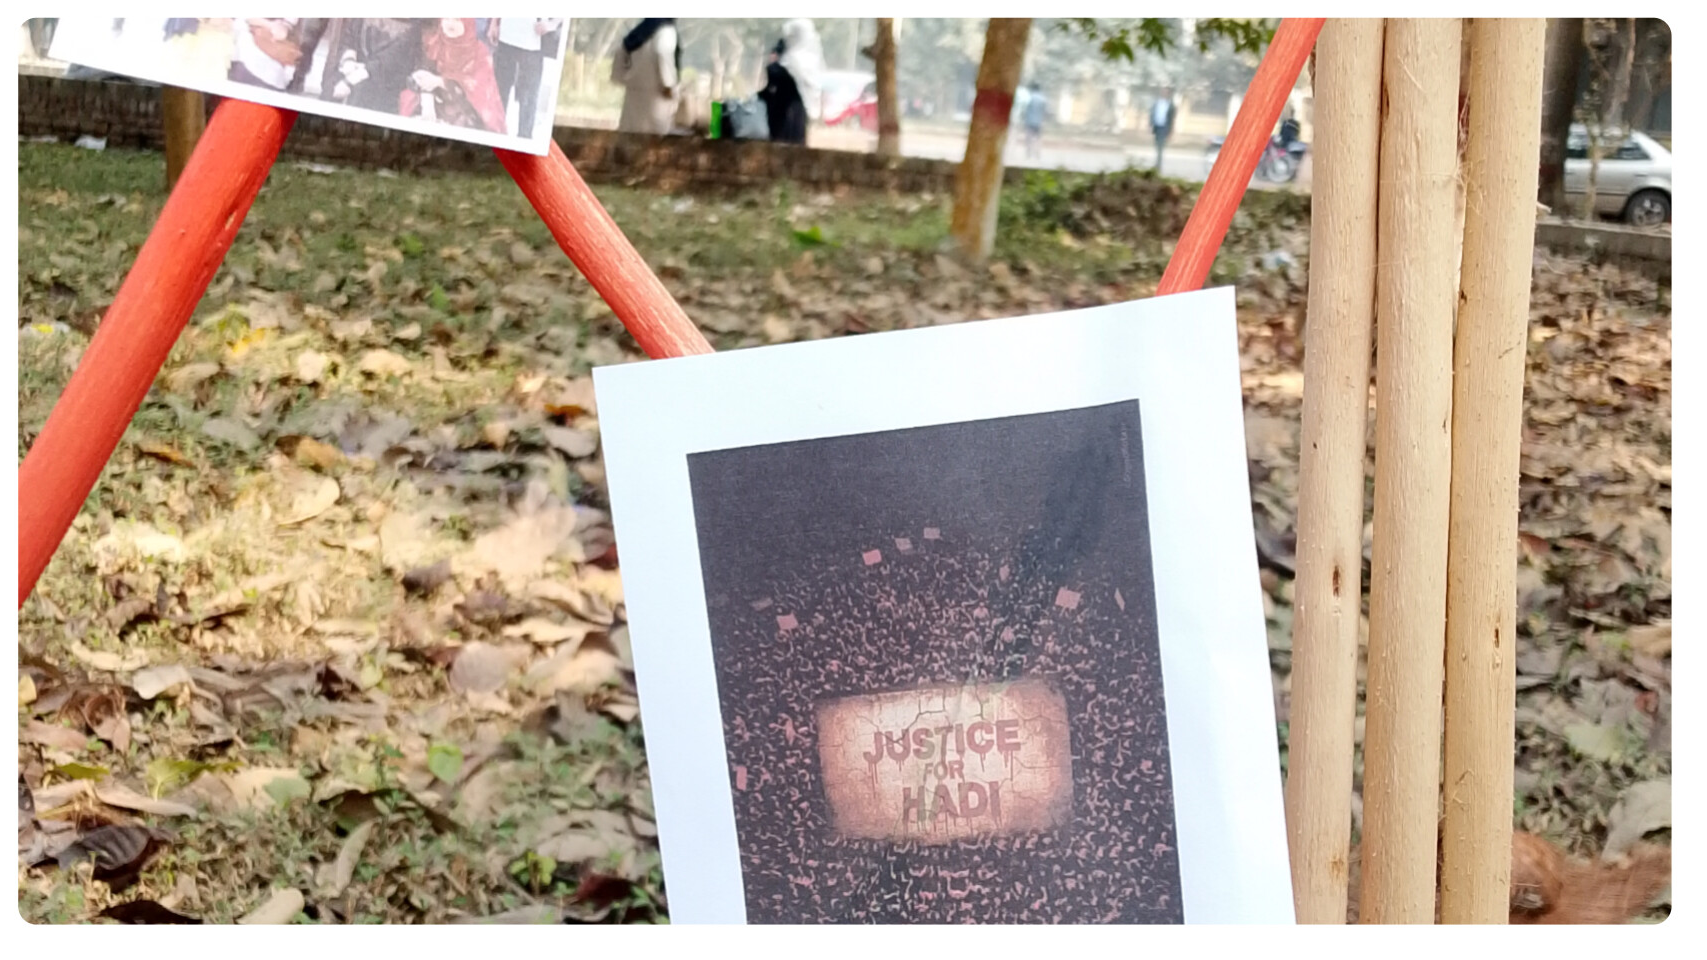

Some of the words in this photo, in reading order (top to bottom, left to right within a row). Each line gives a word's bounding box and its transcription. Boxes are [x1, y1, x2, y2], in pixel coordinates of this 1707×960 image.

[863, 719, 1022, 766] JUSTICE
[923, 760, 965, 782] FOR
[902, 780, 1003, 824] HADI
